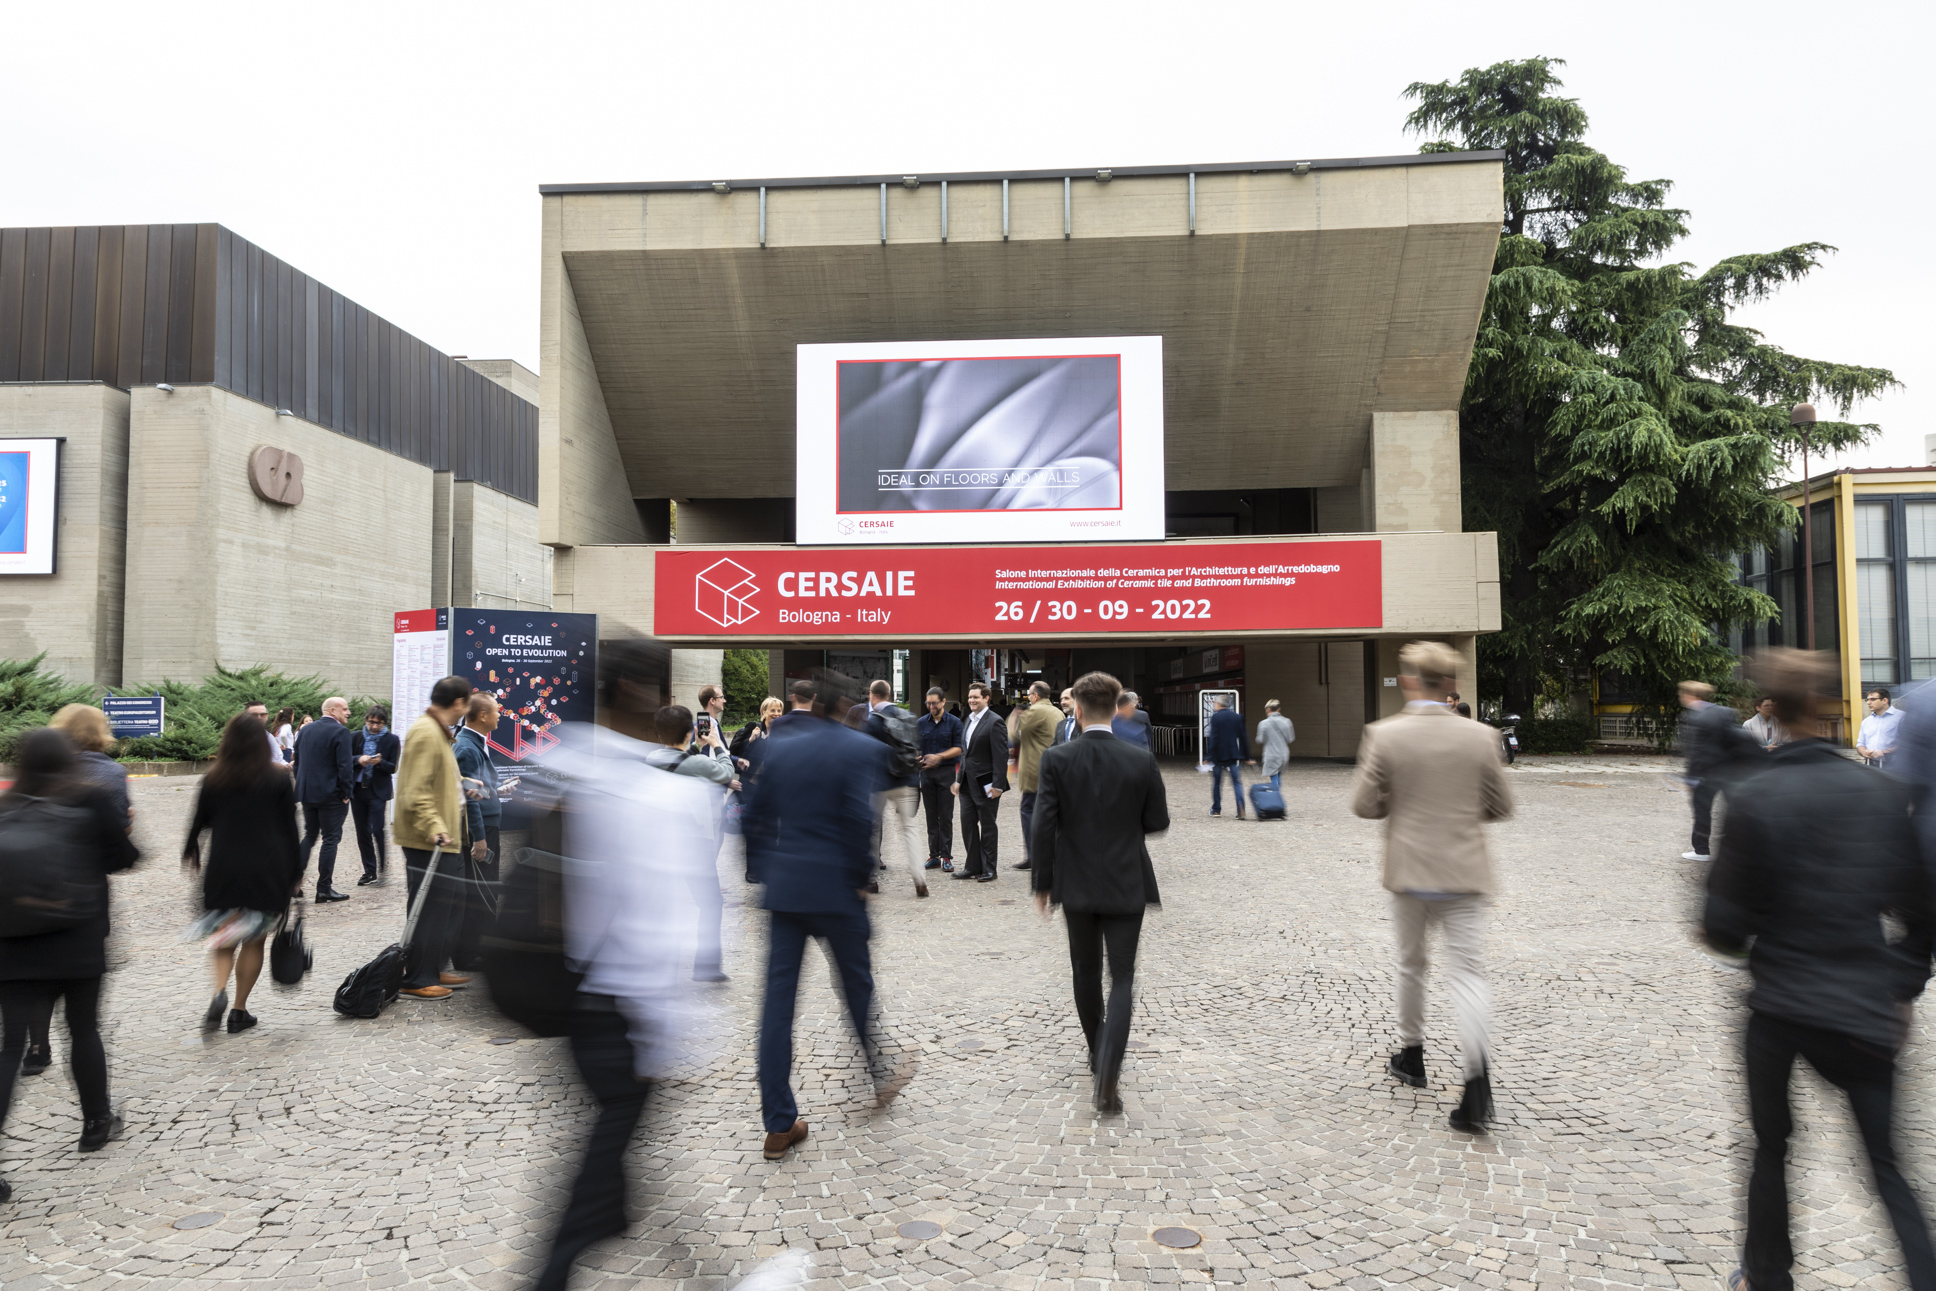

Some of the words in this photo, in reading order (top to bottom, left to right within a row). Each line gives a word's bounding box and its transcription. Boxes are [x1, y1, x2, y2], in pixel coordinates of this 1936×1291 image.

[878, 474, 915, 486] IDEAL
[919, 474, 940, 485] ON
[944, 473, 998, 485] FLOORS
[1002, 472, 1030, 484] AND
[1034, 471, 1080, 483] WALLS
[859, 520, 895, 528] CERSAIE
[1070, 519, 1122, 528] www.cersaie.it
[995, 569, 1027, 578] Salone
[1028, 568, 1096, 578] Internazionale
[1098, 567, 1121, 577] della
[1122, 567, 1166, 577] Ceramica
[1167, 567, 1184, 577] per
[1185, 566, 1248, 576] l'Architettura
[1257, 564, 1340, 575] dell'Arredobagno
[777, 571, 916, 598] CERSAIE
[995, 579, 1056, 589] International
[1057, 579, 1105, 588] Exhibition
[1106, 578, 1117, 588] of
[1118, 578, 1155, 588] Ceramic
[1157, 578, 1172, 587] tile
[1174, 578, 1192, 587] and
[1194, 577, 1241, 587] Bathroom
[1243, 576, 1296, 586] furnishings
[994, 600, 1024, 621] 26
[1047, 600, 1077, 621] 30
[1098, 600, 1129, 620] 09
[1151, 599, 1212, 620] 2022
[779, 608, 841, 626] Bologna
[857, 608, 892, 626] Italy
[502, 634, 553, 647] CERSAIE
[486, 648, 509, 656] OPEN
[510, 648, 522, 656] TO
[523, 648, 567, 657] EVOLUTION
